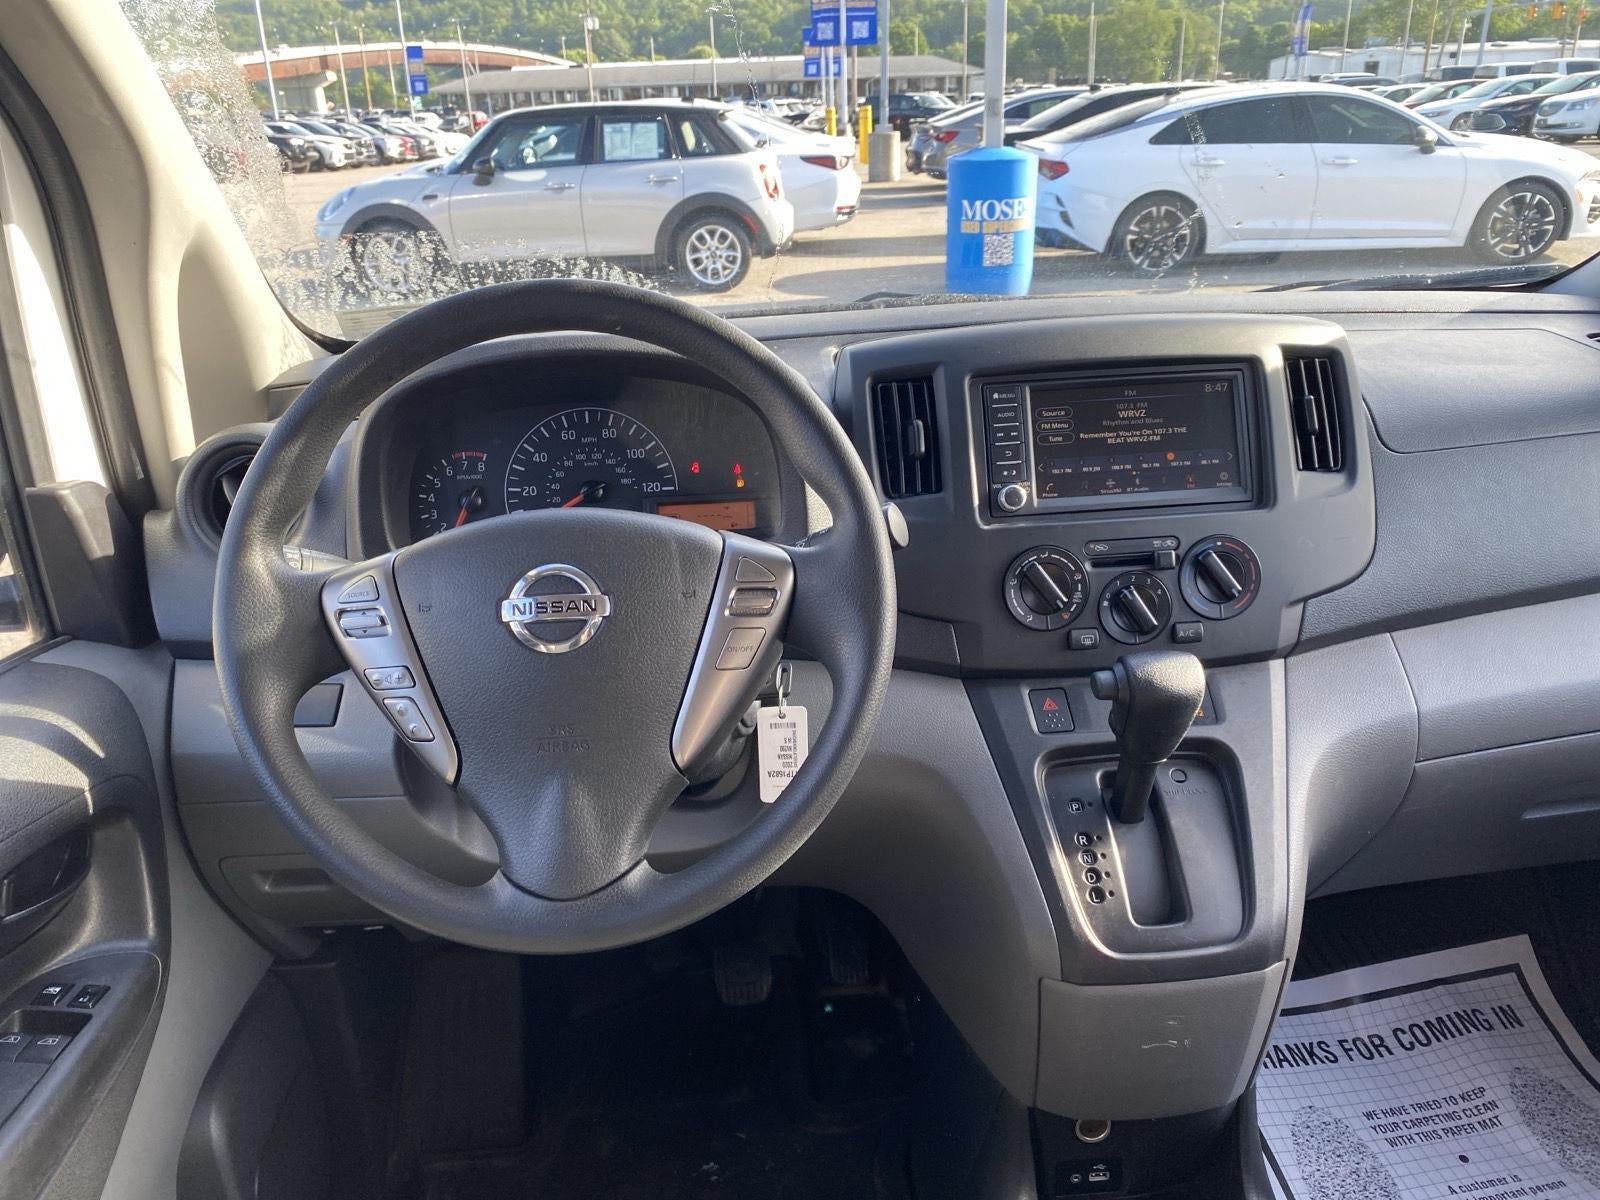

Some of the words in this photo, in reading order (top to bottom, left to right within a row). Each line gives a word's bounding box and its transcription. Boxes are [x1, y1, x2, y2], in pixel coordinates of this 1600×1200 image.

[1205, 382, 1228, 392] 8:47
[1118, 410, 1147, 418] WRVZ
[561, 430, 576, 440] 60
[602, 428, 617, 438] 80
[1079, 431, 1117, 439] Remember
[1126, 435, 1161, 443] WRVZ-FM
[532, 452, 548, 463] 40
[626, 448, 645, 459] 100
[446, 466, 453, 476] 6
[461, 460, 468, 471] 7
[478, 462, 485, 472] 8
[434, 478, 441, 488] 5
[642, 482, 661, 492] 120
[522, 485, 537, 496] 20
[428, 493, 435, 503] 4
[431, 509, 438, 520] 3
[440, 522, 447, 533] 2
[512, 600, 597, 616] NISSAN
[1179, 629, 1194, 638] A/C
[1079, 835, 1088, 846] R
[1083, 855, 1092, 864] N
[1087, 873, 1096, 883] D
[1091, 891, 1100, 902] L
[1263, 1040, 1339, 1069] HANKS
[1337, 1033, 1395, 1062] FOR
[1392, 1008, 1496, 1051] COMING
[1490, 1004, 1525, 1030] IN
[1362, 1110, 1382, 1121] WE
[1380, 1105, 1411, 1119] HAVE
[1409, 1099, 1443, 1114] TRIED
[1441, 1095, 1459, 1107] TO
[1459, 1086, 1487, 1103] KEEP
[1369, 1121, 1403, 1135] YOUR
[1402, 1110, 1463, 1131] CARPETING
[1462, 1099, 1500, 1118] CLEAN
[1384, 1134, 1417, 1148] WITH
[1416, 1130, 1443, 1143] THIS
[1441, 1123, 1479, 1138] PAPER
[1476, 1115, 1504, 1132] MAT
[1447, 1184, 1458, 1196] A
[1458, 1176, 1510, 1193] customer
[1509, 1174, 1522, 1183] is
[1528, 1179, 1567, 1196] person
